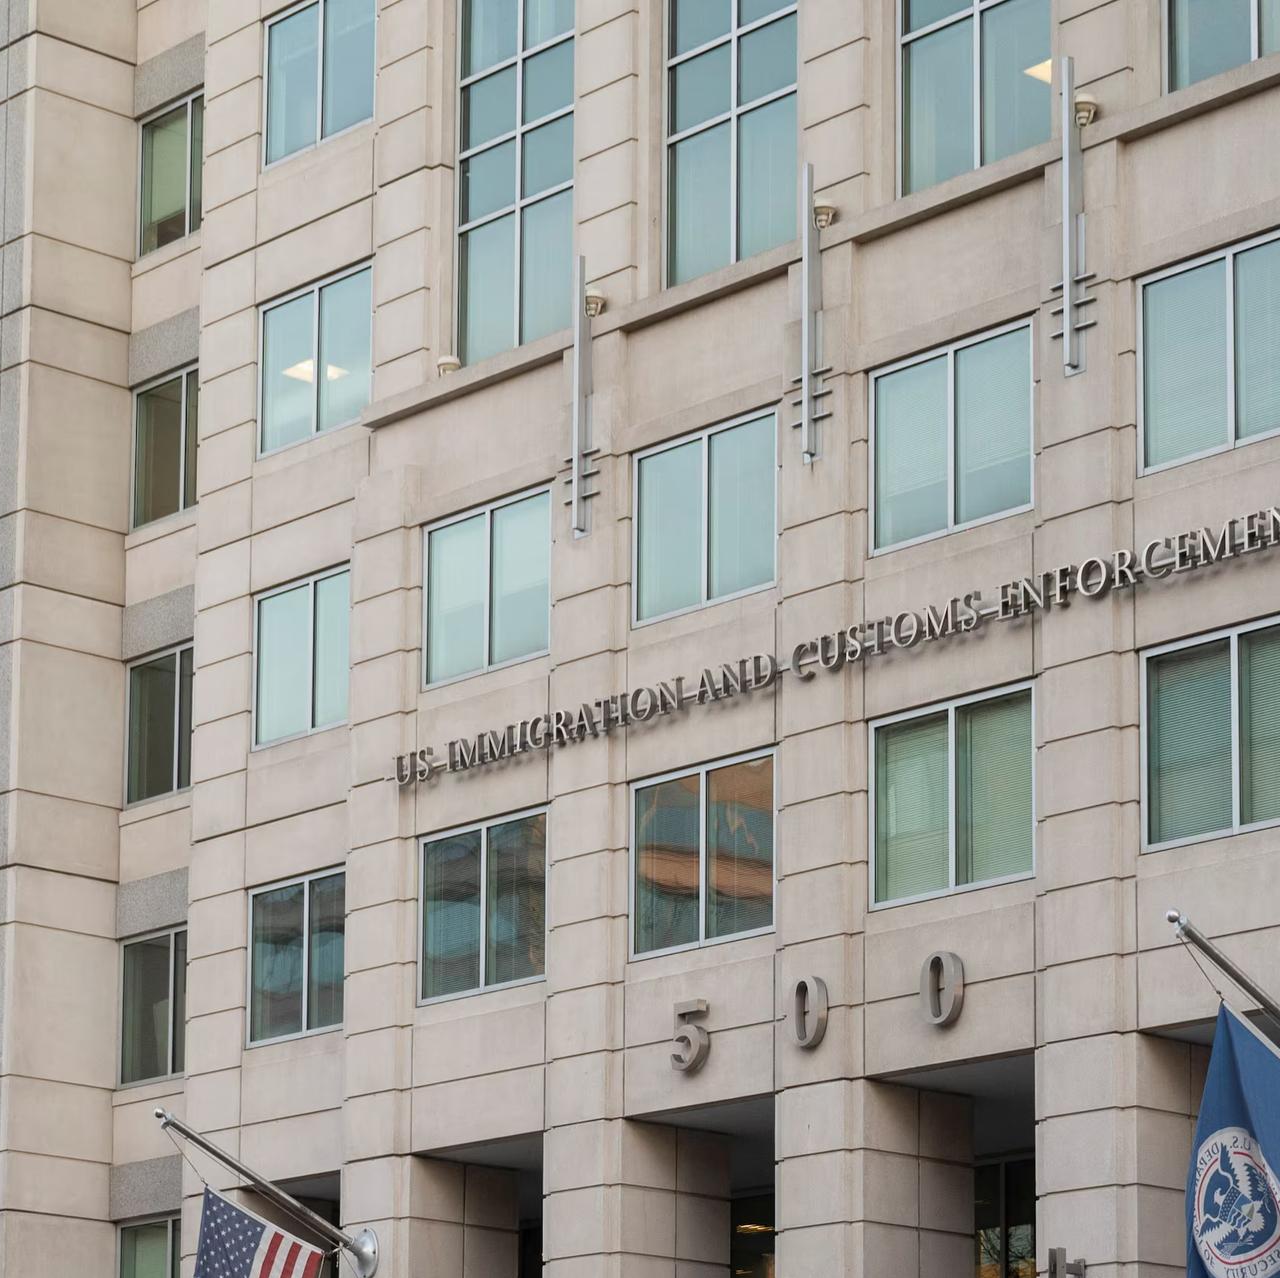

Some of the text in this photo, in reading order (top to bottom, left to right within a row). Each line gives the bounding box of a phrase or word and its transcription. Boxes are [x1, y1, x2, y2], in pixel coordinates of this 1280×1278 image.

[392, 747, 433, 786] US
[444, 676, 684, 773] IMMIGRATION
[695, 653, 778, 705] AND
[790, 590, 982, 682] CUSTOMS
